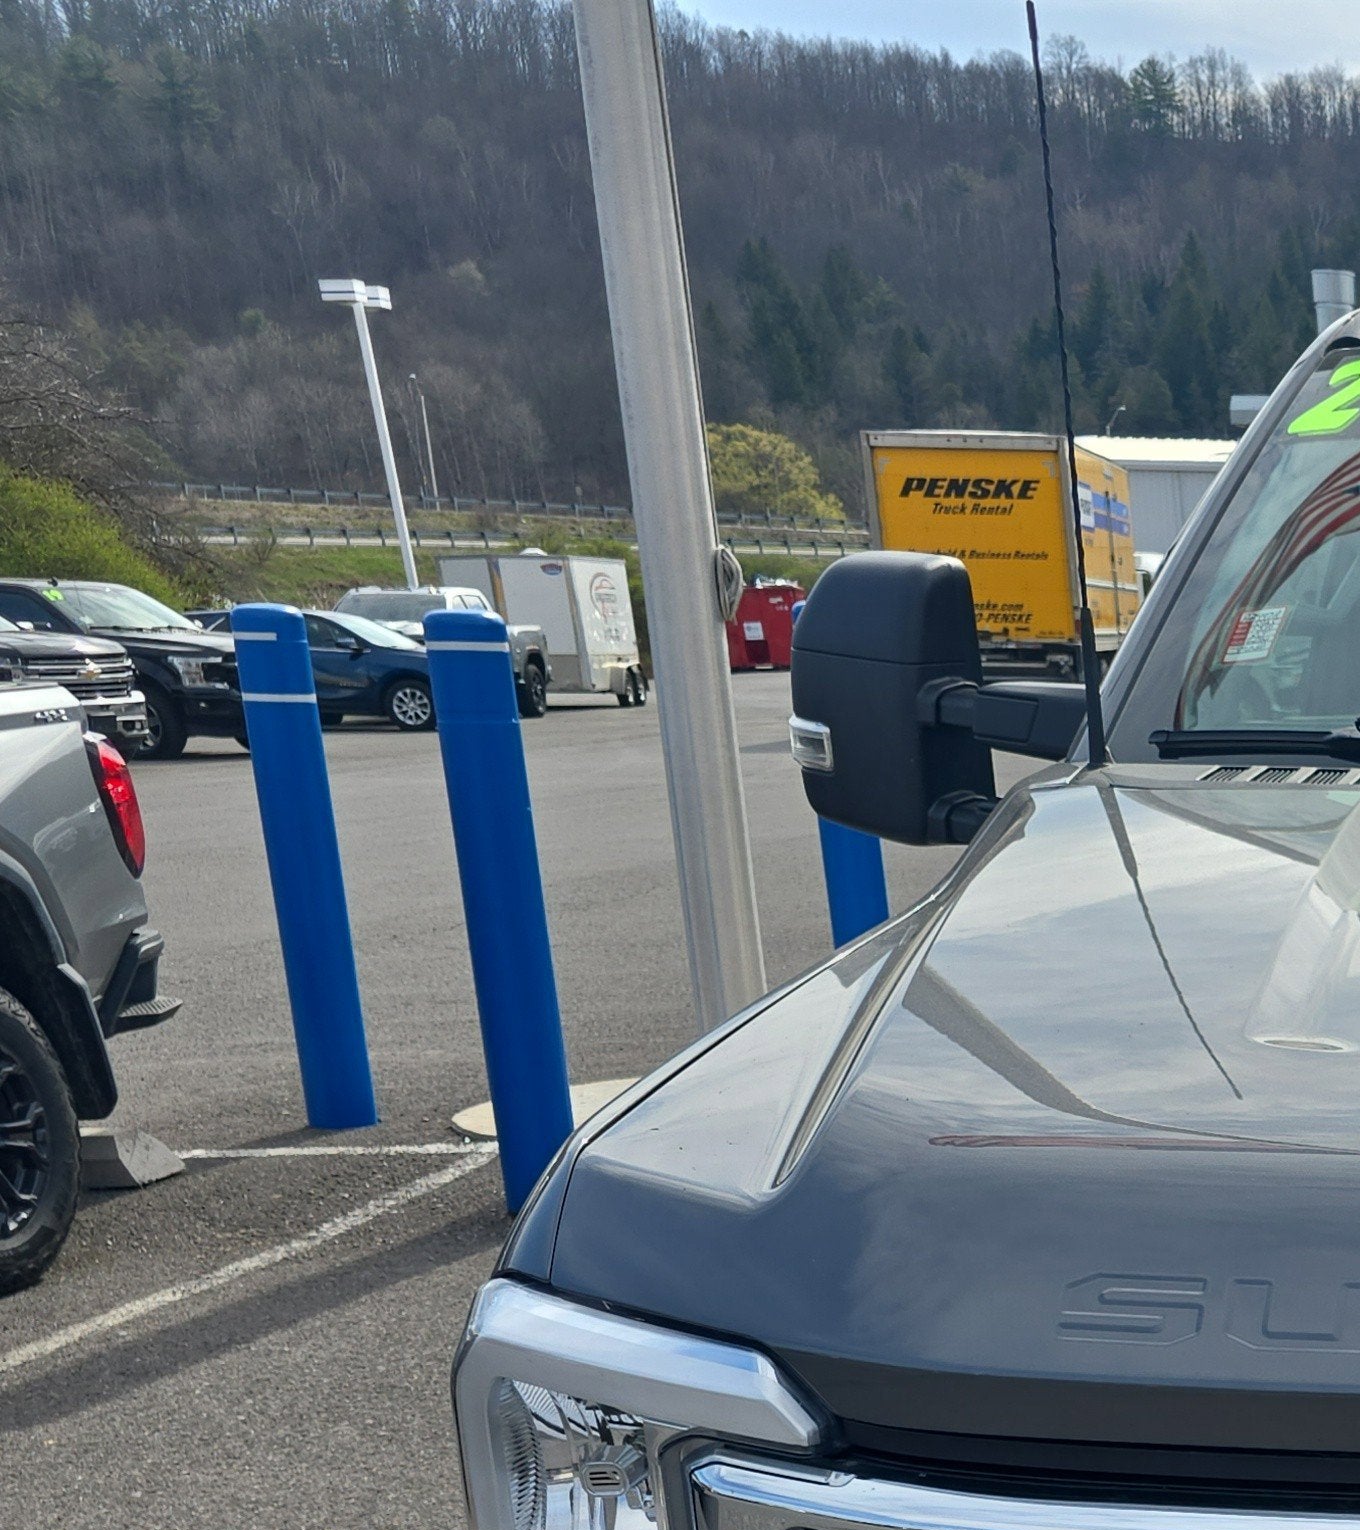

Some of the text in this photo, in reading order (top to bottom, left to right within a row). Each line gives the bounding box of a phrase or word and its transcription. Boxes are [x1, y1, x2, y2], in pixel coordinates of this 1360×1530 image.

[899, 477, 1040, 500] PENSKE
[932, 503, 1014, 516] Truck Rental
[968, 550, 1011, 560] Business
[1013, 551, 1049, 561] Rentals
[974, 599, 1024, 610] nske.com
